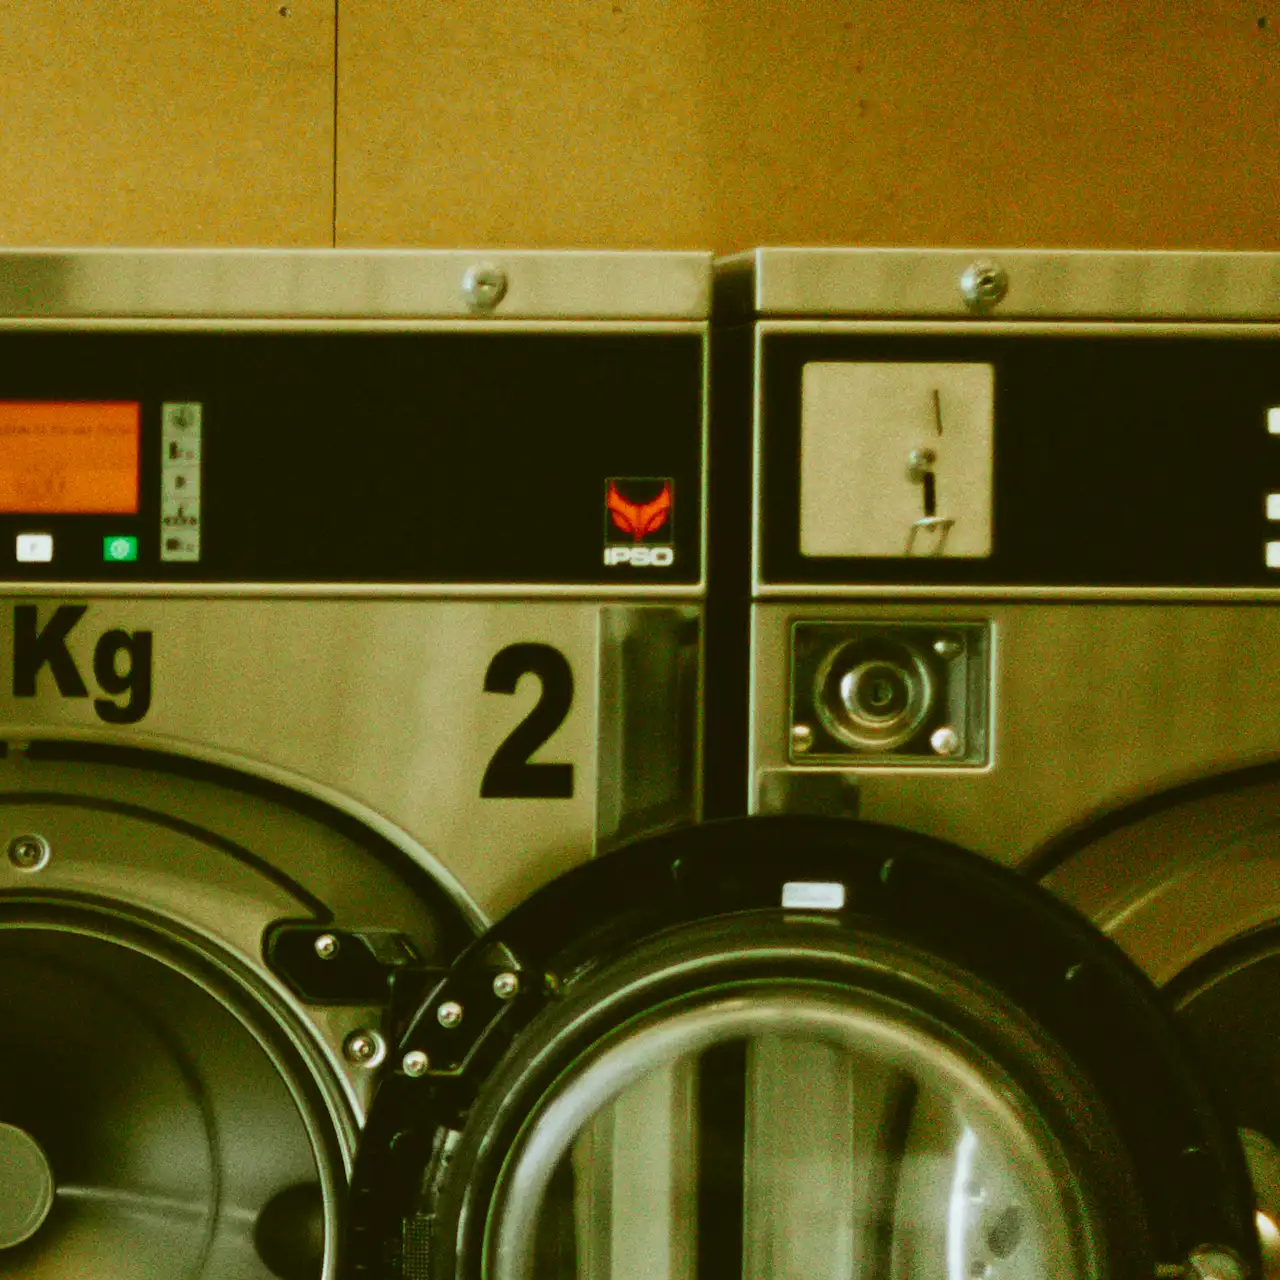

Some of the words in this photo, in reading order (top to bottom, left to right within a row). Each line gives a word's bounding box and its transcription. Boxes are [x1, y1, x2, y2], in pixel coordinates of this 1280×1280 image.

[604, 546, 674, 566] IPSO
[12, 604, 154, 725] Kg
[480, 643, 574, 799] 2
